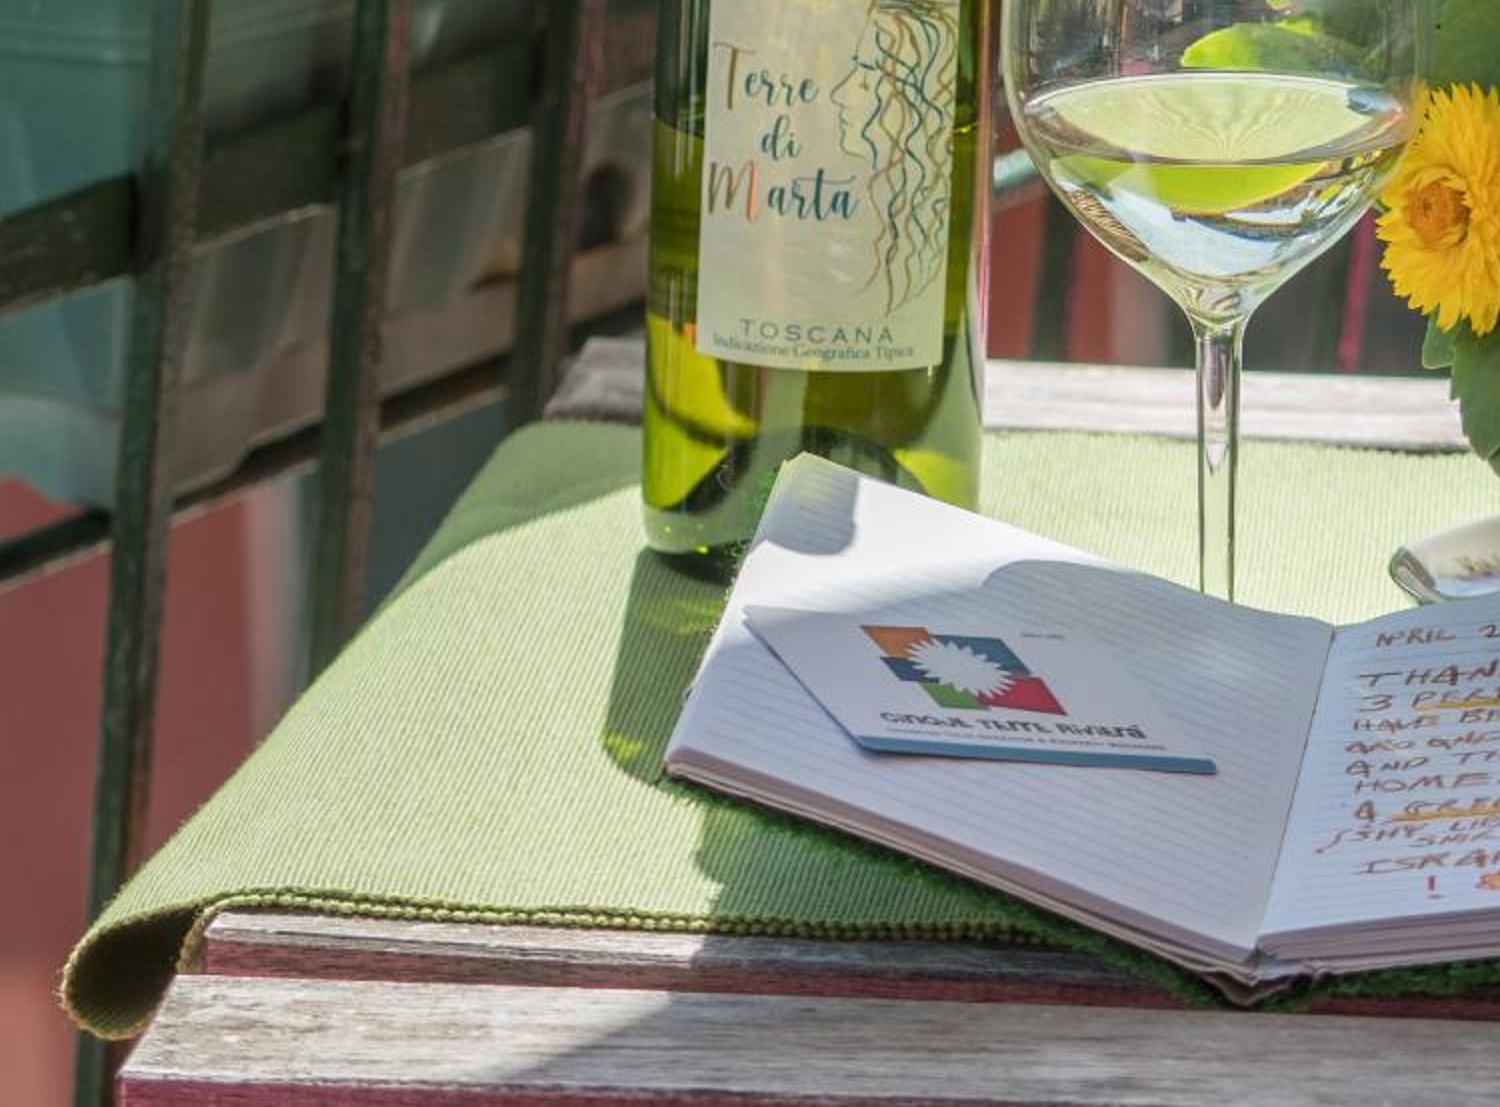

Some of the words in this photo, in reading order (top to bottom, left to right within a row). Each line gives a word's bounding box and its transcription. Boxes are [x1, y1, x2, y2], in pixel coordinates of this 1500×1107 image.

[713, 42, 817, 110] Terre
[760, 114, 802, 161] di
[707, 160, 858, 223] Marta
[740, 318, 893, 343] TOSCANA
[1359, 694, 1392, 711] 3
[1345, 757, 1429, 778] AND
[1354, 800, 1377, 823] A
